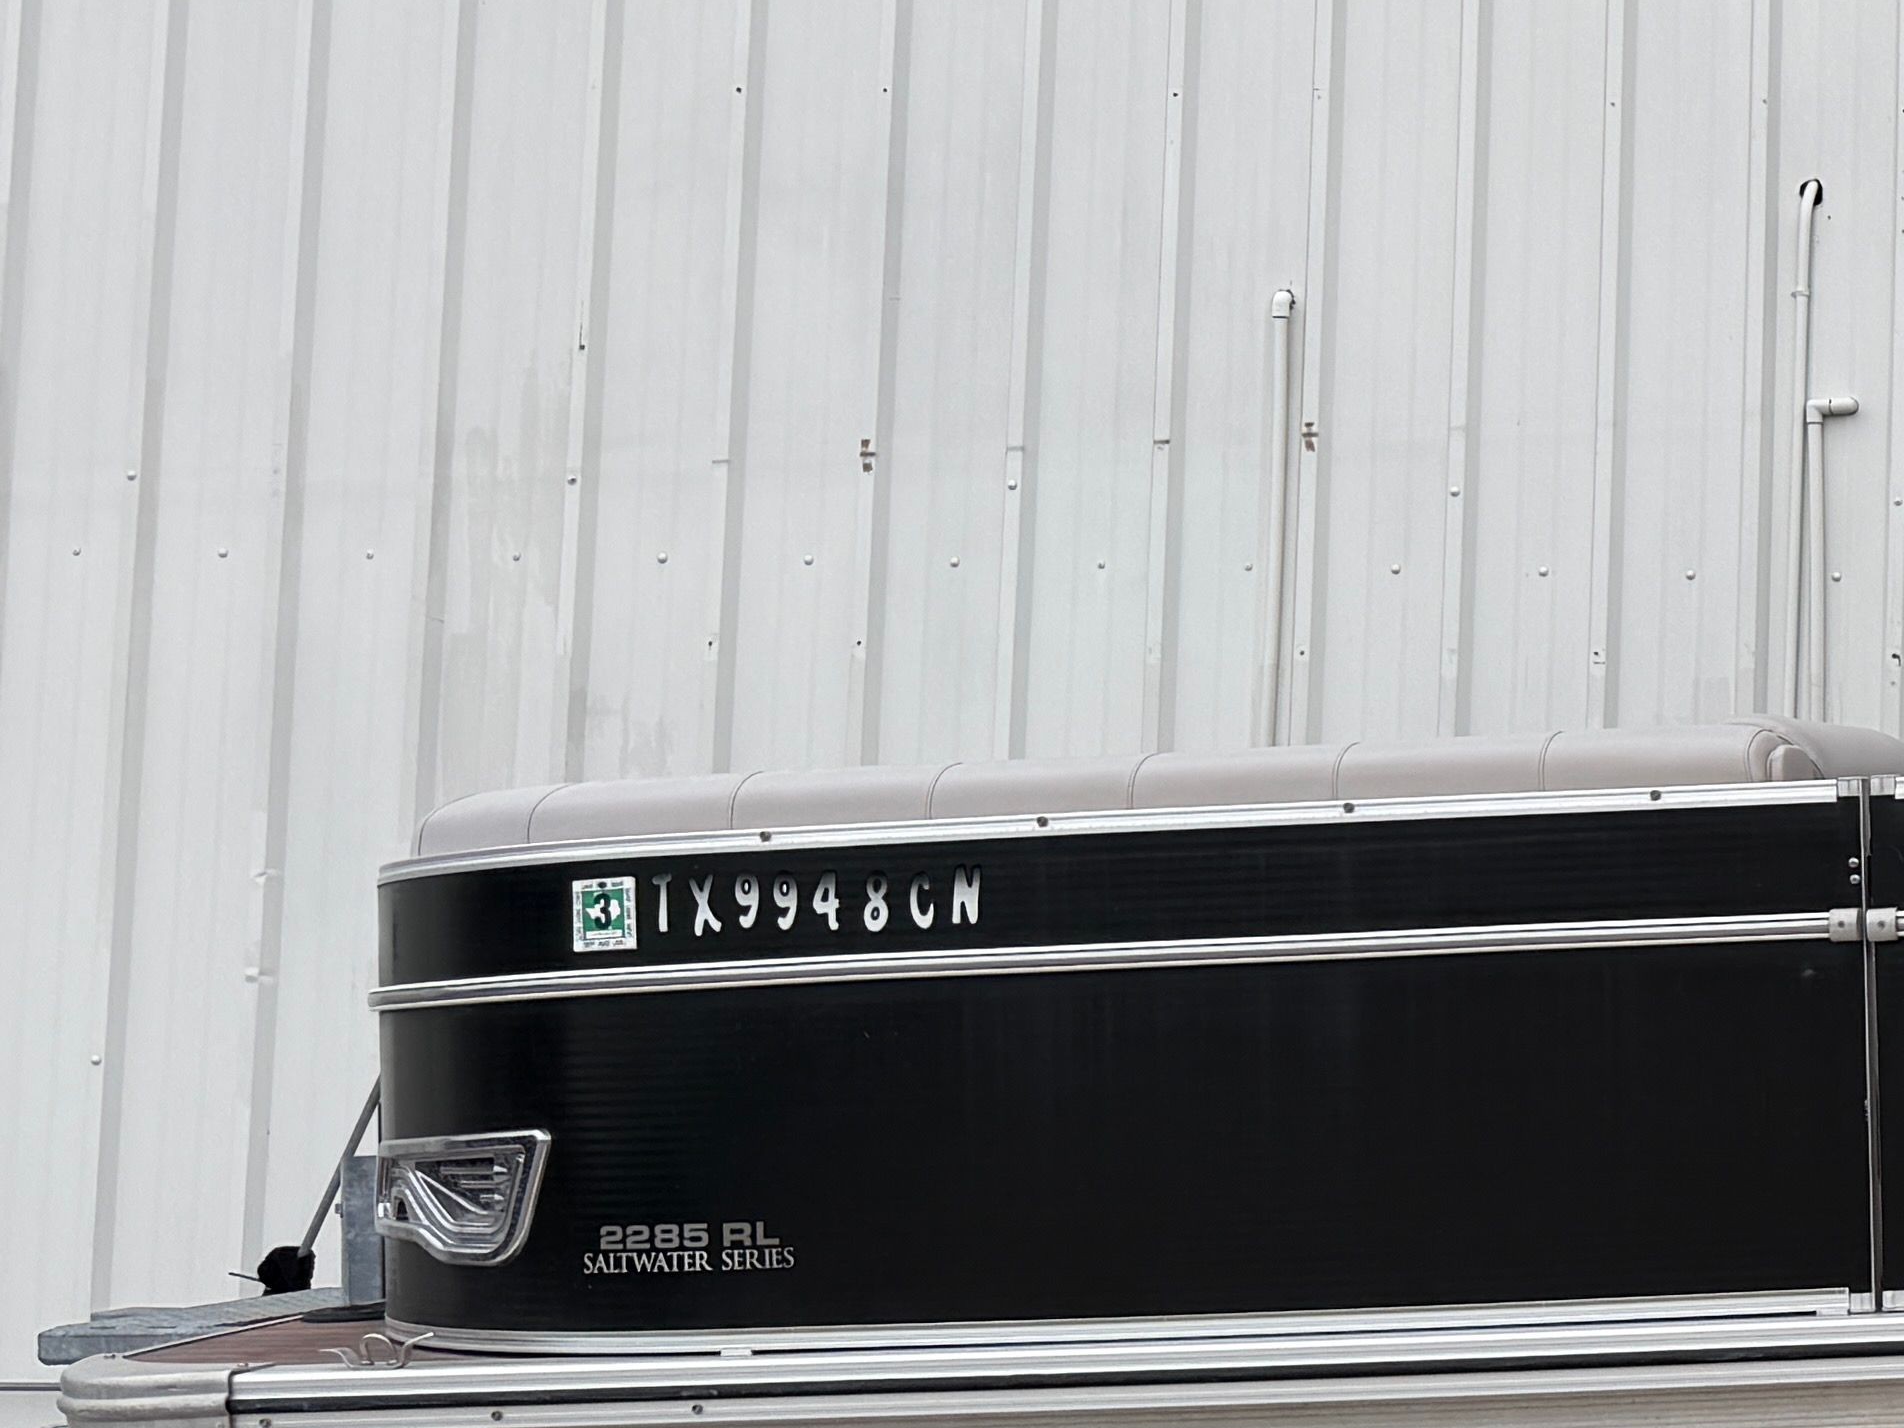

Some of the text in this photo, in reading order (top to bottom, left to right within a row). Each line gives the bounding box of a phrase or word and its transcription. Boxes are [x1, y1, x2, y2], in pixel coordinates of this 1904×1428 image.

[594, 893, 612, 930] 3
[600, 1221, 780, 1250] 2285 RL
[583, 1247, 795, 1274] SALTWATER SERIES
